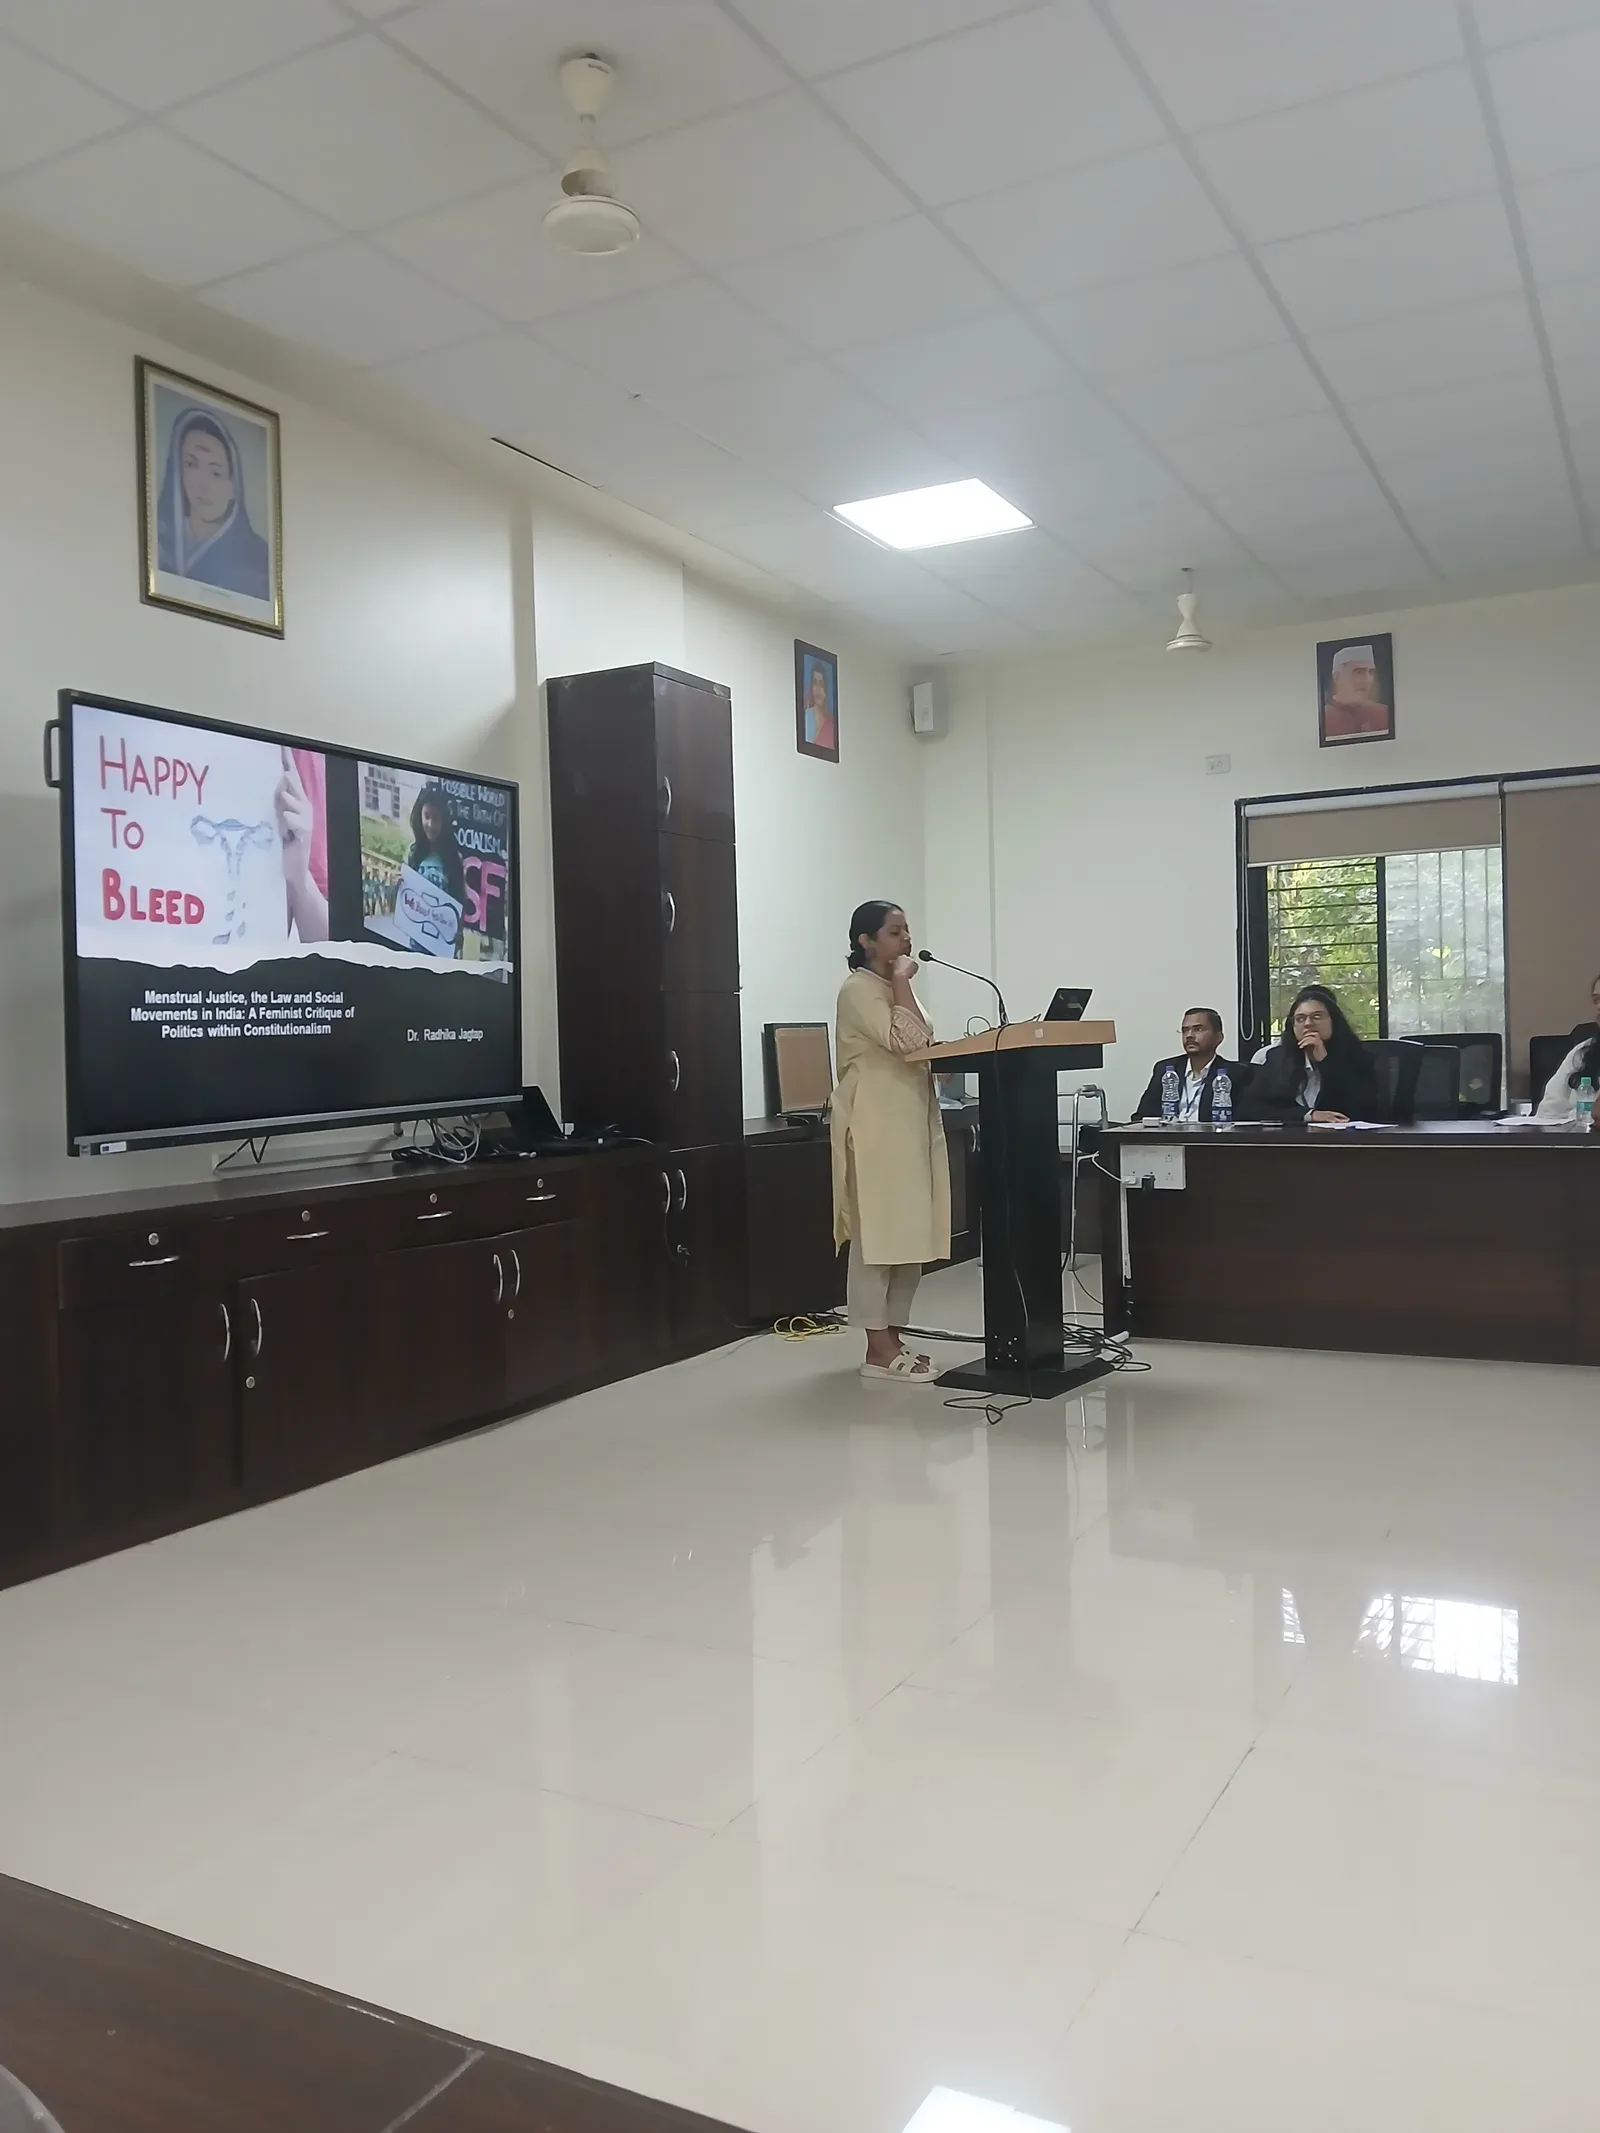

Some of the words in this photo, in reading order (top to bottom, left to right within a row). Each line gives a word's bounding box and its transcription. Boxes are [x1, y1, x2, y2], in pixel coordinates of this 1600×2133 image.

[99, 735, 209, 805] HAPPY
[478, 785, 504, 807] WORLD
[102, 868, 205, 924] BLEED
[145, 990, 202, 1004] Menstrual
[206, 990, 247, 1005] Justice,
[251, 991, 268, 1003] the
[270, 991, 292, 1003] Law
[293, 991, 312, 1003] and
[315, 991, 344, 1003] Social
[131, 1007, 198, 1021] Movements
[202, 1007, 212, 1020] in
[215, 1007, 245, 1020] India:
[248, 1007, 257, 1019] A
[259, 1007, 302, 1019] Feminist
[305, 1006, 342, 1021] Critique
[345, 1006, 355, 1018] of
[162, 1025, 203, 1038] Politics
[207, 1024, 241, 1037] within
[243, 1023, 331, 1036] Constitutionalism
[407, 1029, 419, 1041] Dr.
[424, 1028, 456, 1040] Radhika
[458, 1028, 484, 1042] Jagtap
